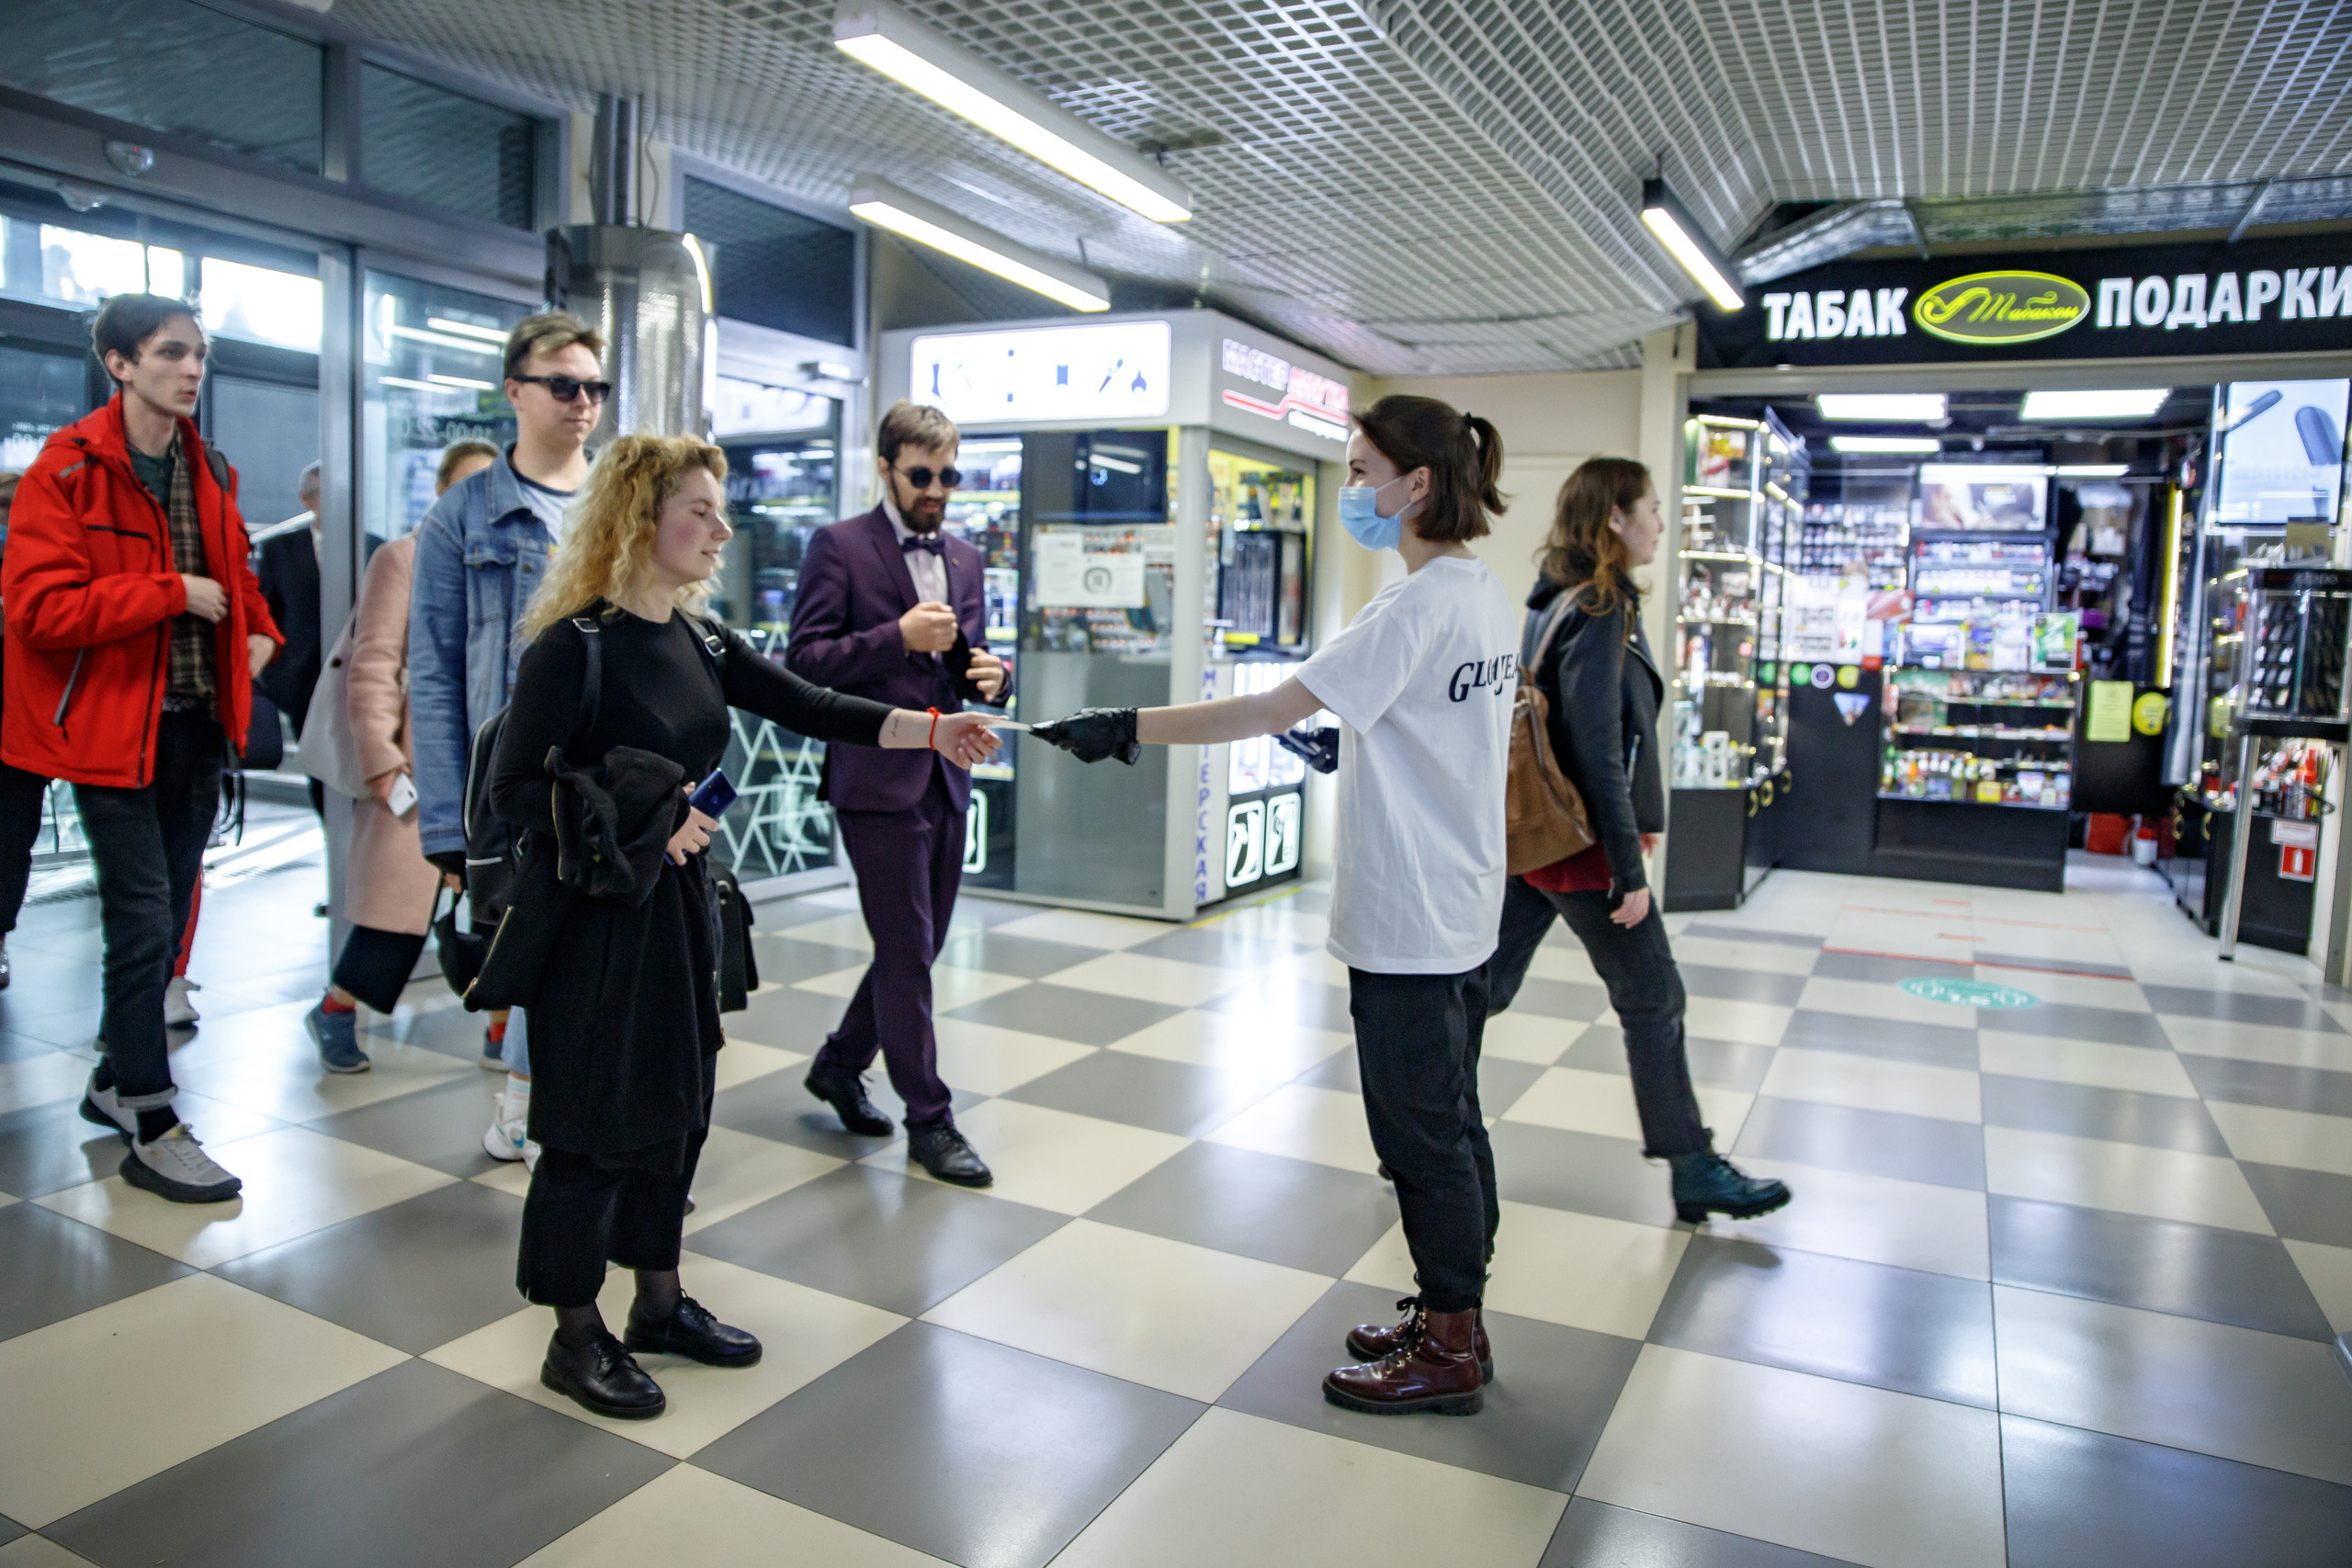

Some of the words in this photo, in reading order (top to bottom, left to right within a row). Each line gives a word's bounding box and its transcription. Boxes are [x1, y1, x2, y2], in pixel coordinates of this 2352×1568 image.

[1763, 288, 1909, 340] ТАБАК
[2098, 265, 2352, 330] ПОДАРКИ
[1194, 669, 1217, 903] МТЕРСКАЯ
